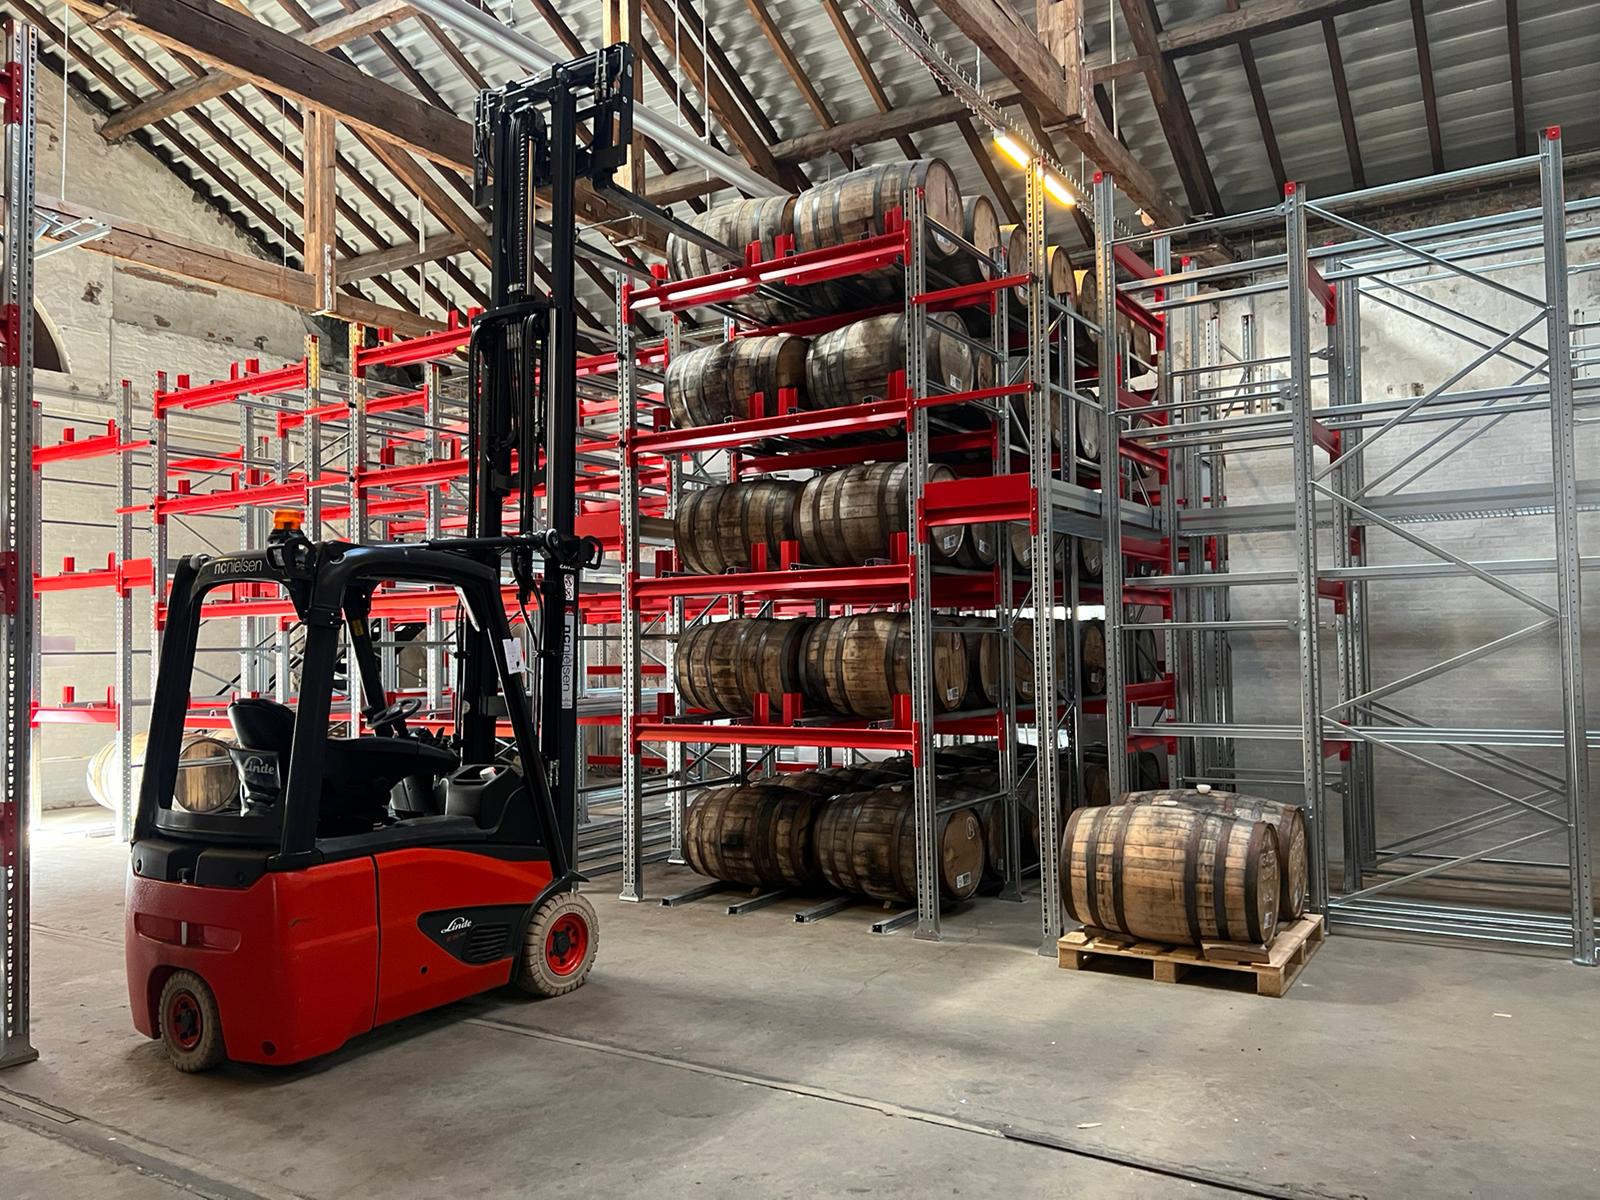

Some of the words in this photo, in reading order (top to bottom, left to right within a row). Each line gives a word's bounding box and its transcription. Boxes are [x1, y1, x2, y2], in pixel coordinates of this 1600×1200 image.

[214, 558, 262, 575] ncnielsen
[562, 624, 571, 692] ncnielsen
[243, 756, 275, 774] Linde
[440, 916, 472, 934] Linde
